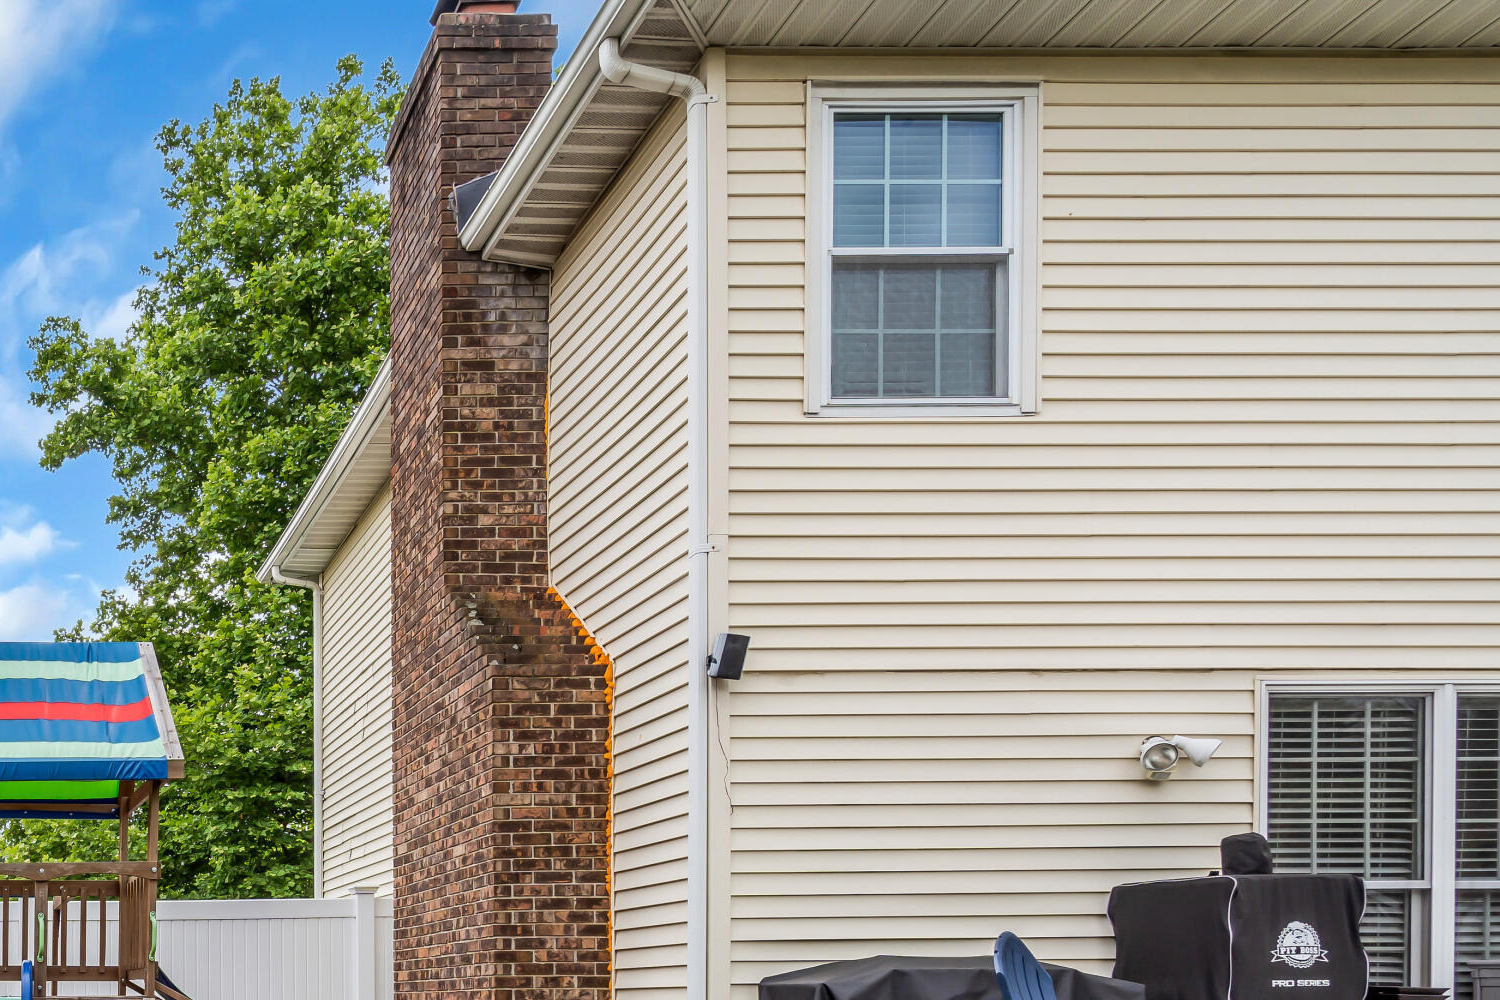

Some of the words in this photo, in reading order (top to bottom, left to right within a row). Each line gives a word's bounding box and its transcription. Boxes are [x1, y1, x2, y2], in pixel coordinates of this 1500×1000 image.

[1300, 946, 1318, 954] BOSS
[1271, 979, 1295, 987] PRO
[1297, 979, 1330, 987] SERIES
